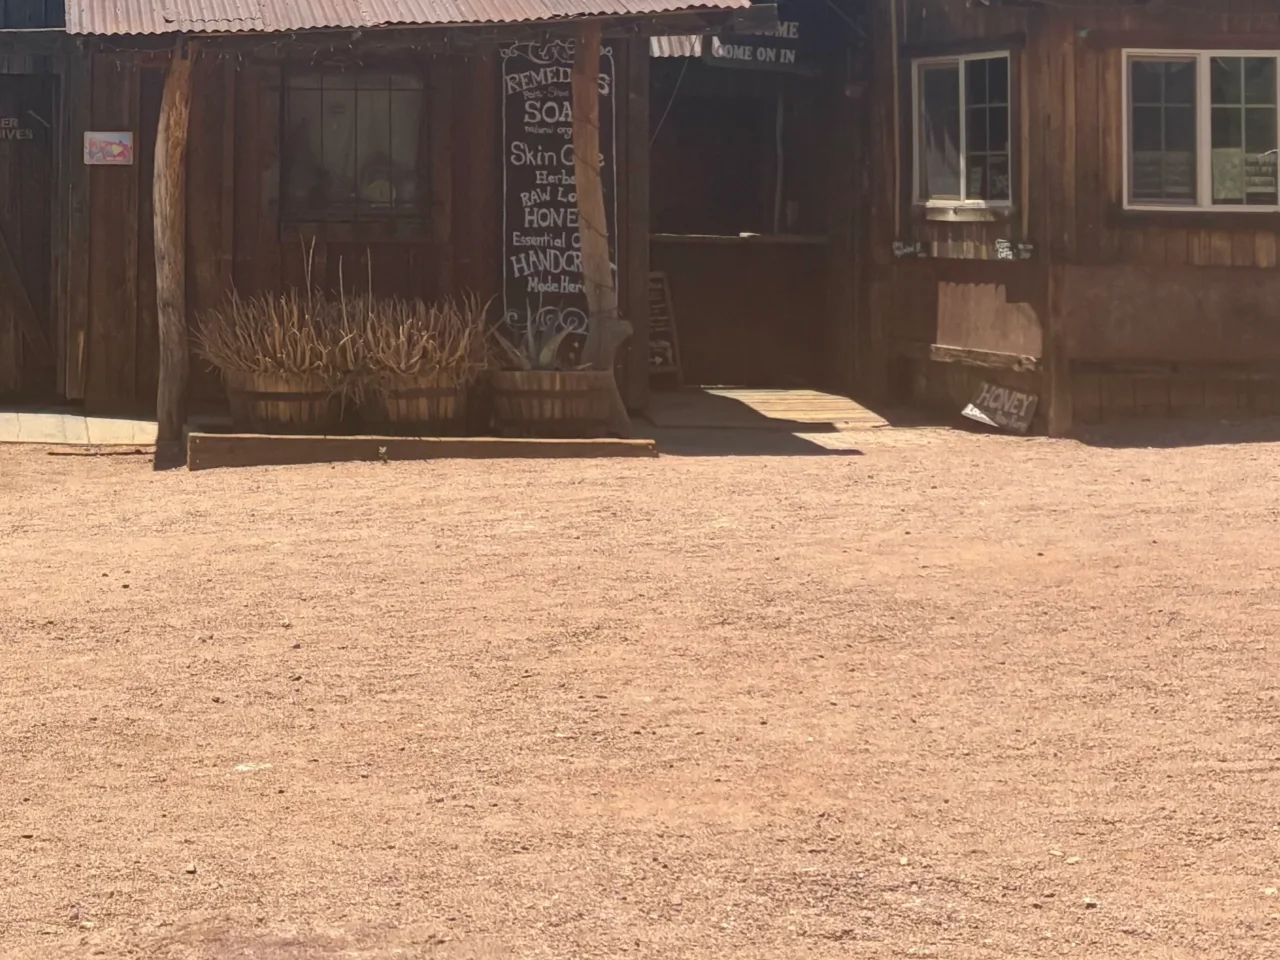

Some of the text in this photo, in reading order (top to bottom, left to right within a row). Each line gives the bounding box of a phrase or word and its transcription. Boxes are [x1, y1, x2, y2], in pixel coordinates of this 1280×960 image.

[756, 46, 777, 62] ON
[780, 48, 797, 63] IN
[505, 66, 611, 96] REMEDS
[523, 101, 574, 123] SOA
[510, 141, 557, 166] Skin
[520, 186, 551, 207] RAW
[524, 207, 580, 228] HONE
[512, 231, 567, 248] Essential
